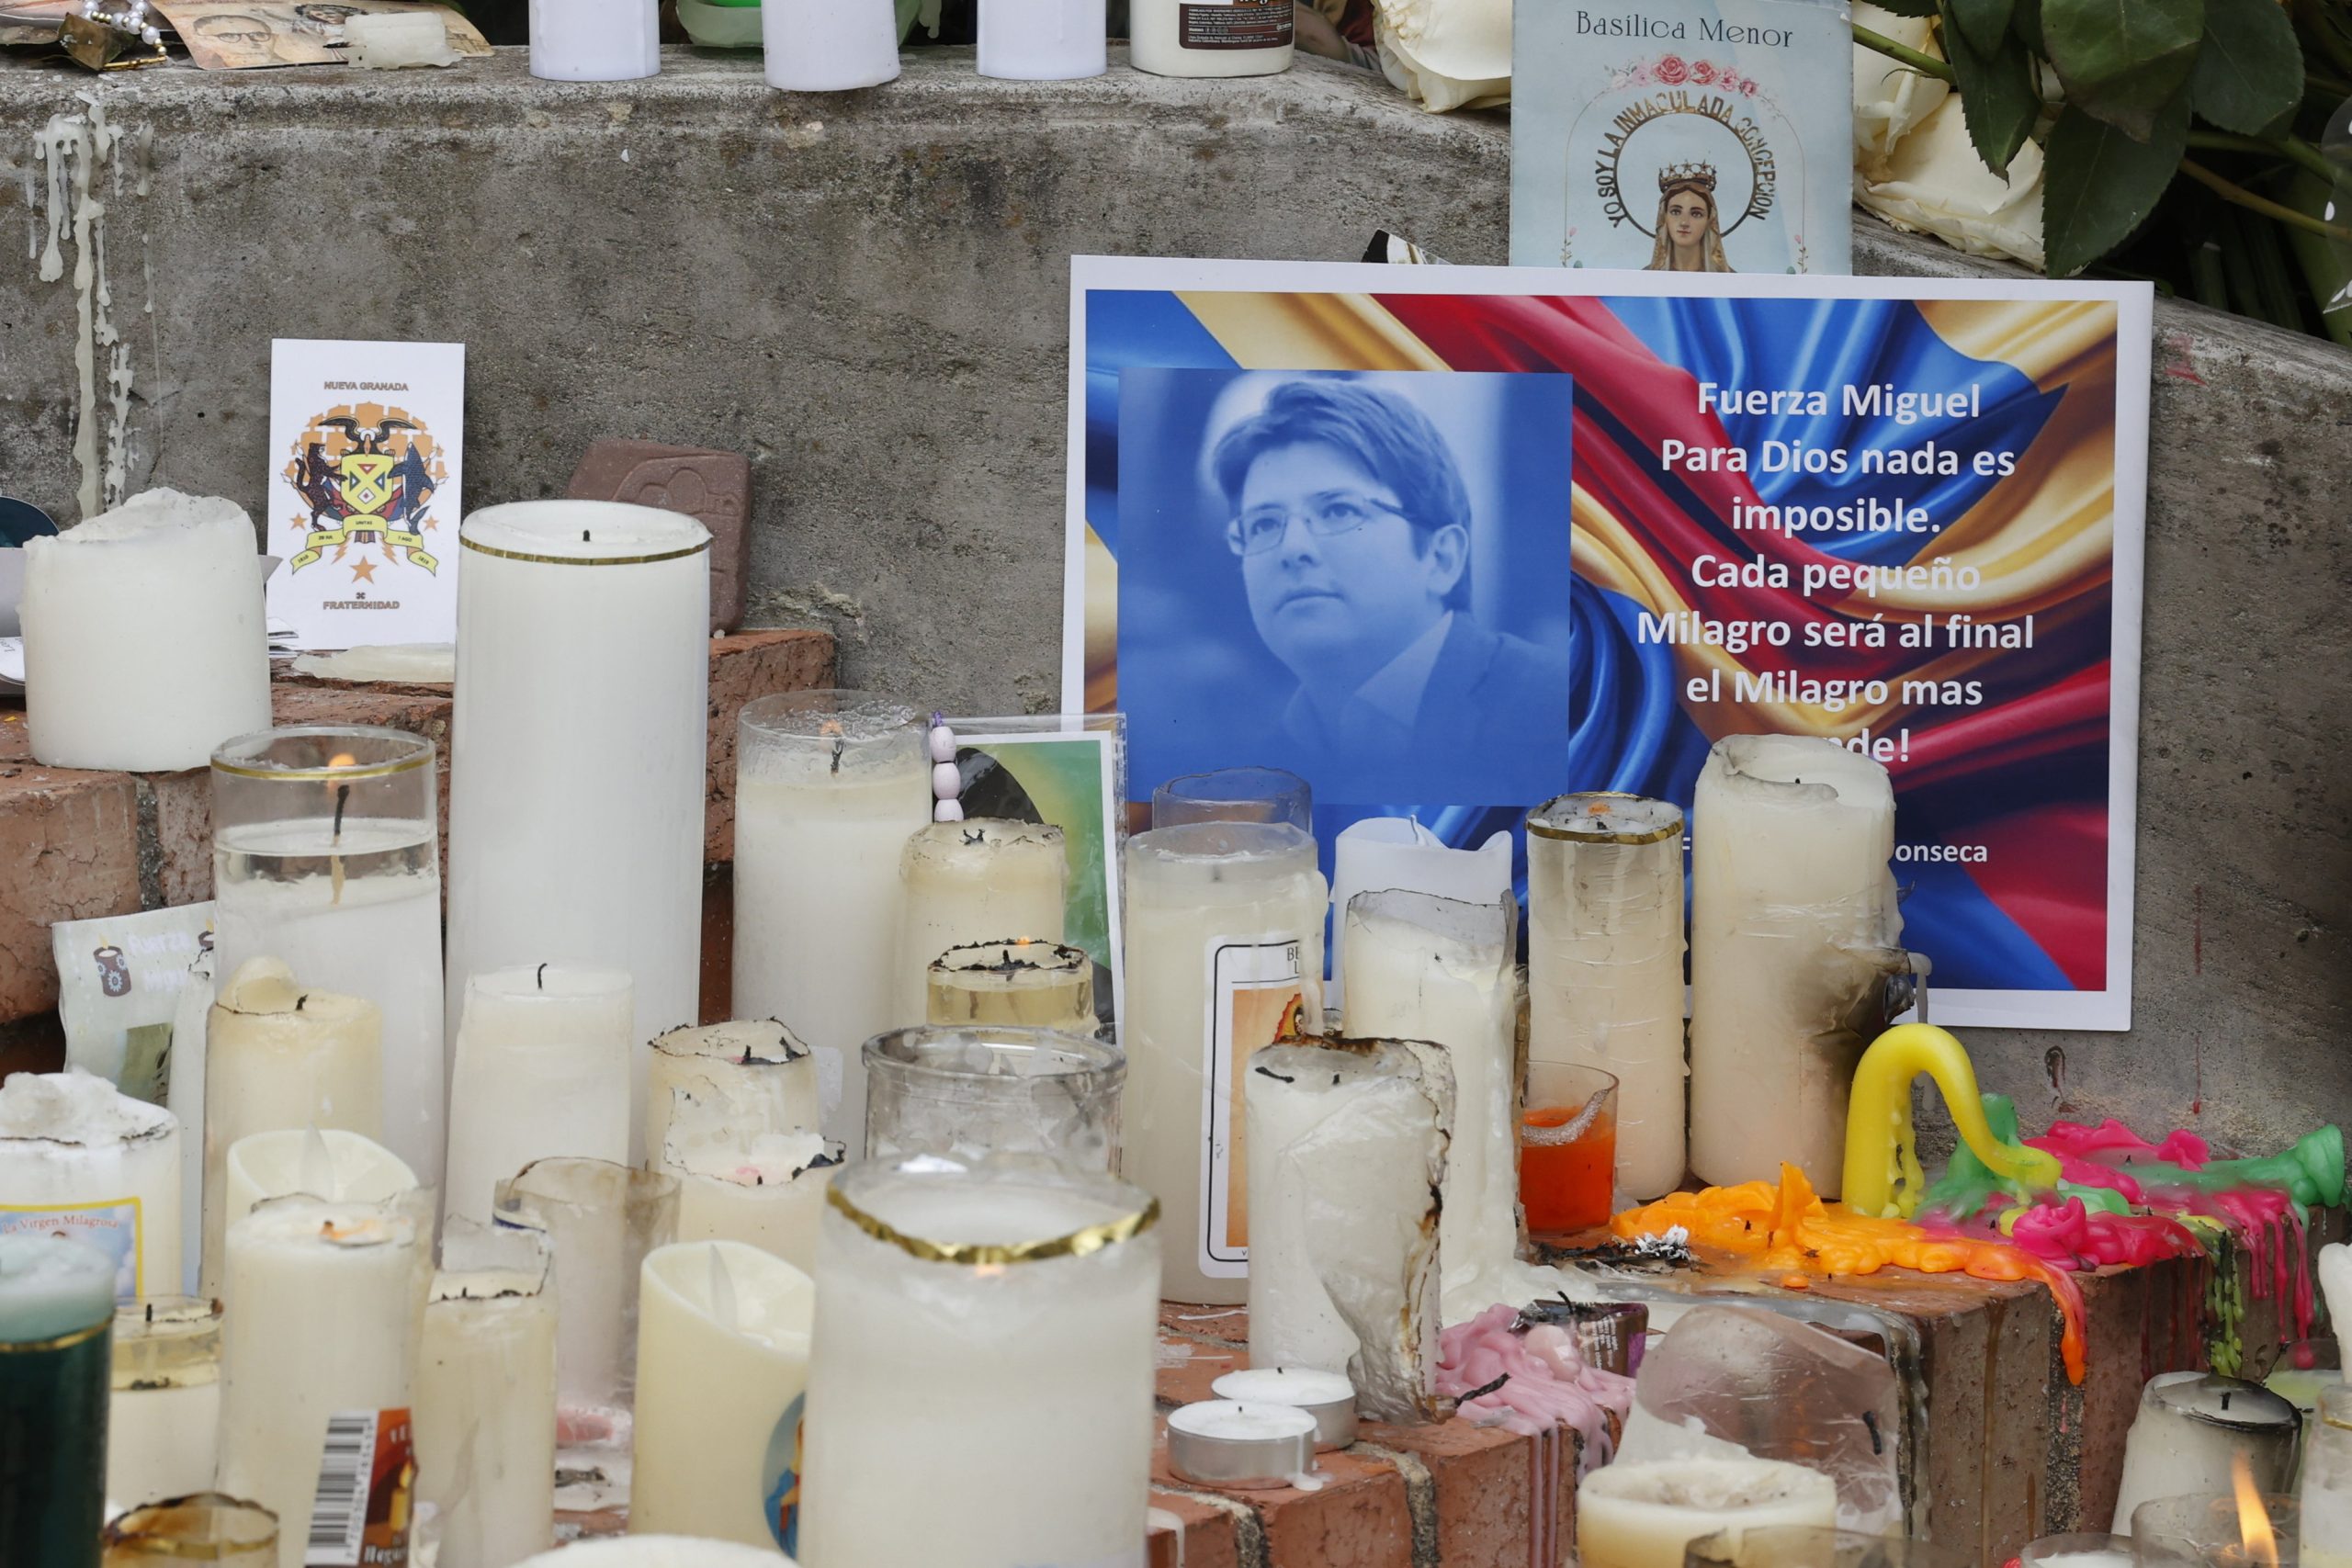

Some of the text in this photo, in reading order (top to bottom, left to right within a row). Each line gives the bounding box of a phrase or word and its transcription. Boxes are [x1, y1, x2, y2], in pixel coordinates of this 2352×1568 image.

[1576, 10, 1793, 48] Basílica Menor
[1612, 90, 1734, 133] INMACULADA
[1597, 131, 1625, 159] LA
[1595, 160, 1615, 199] SOY
[1604, 200, 1628, 228] YO
[323, 381, 410, 391] NUEVA GRANADA
[1698, 382, 1981, 425] Fuerza Miguel
[1661, 439, 2016, 477] Para Dios nada es
[1733, 496, 1941, 539] imposible.
[1690, 553, 1982, 598] Cada pequeño
[322, 601, 401, 610] FRATERNIDAD
[1637, 610, 2033, 654] Milagro será al final
[1686, 668, 1984, 713] el Milagro mas
[1894, 844, 1988, 863] onseca
[19, 1216, 60, 1230] Virgen
[62, 1215, 119, 1229] Milagrosa
